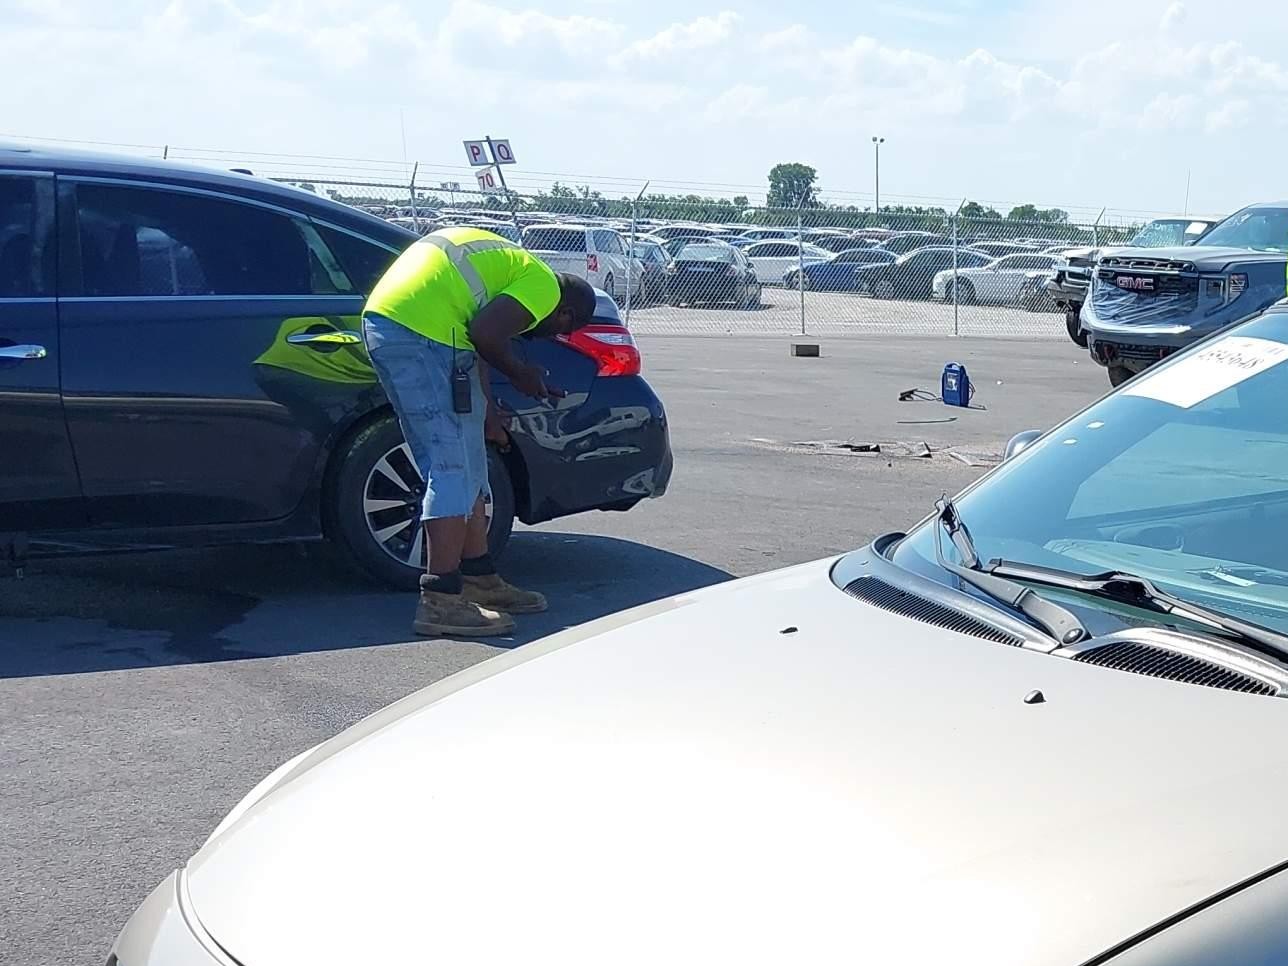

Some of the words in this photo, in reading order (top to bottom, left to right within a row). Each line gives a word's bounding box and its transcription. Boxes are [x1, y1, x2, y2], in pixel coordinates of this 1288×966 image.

[470, 145, 481, 162] P
[497, 144, 512, 160] Q
[478, 172, 494, 190] 70
[1116, 275, 1154, 290] GMC
